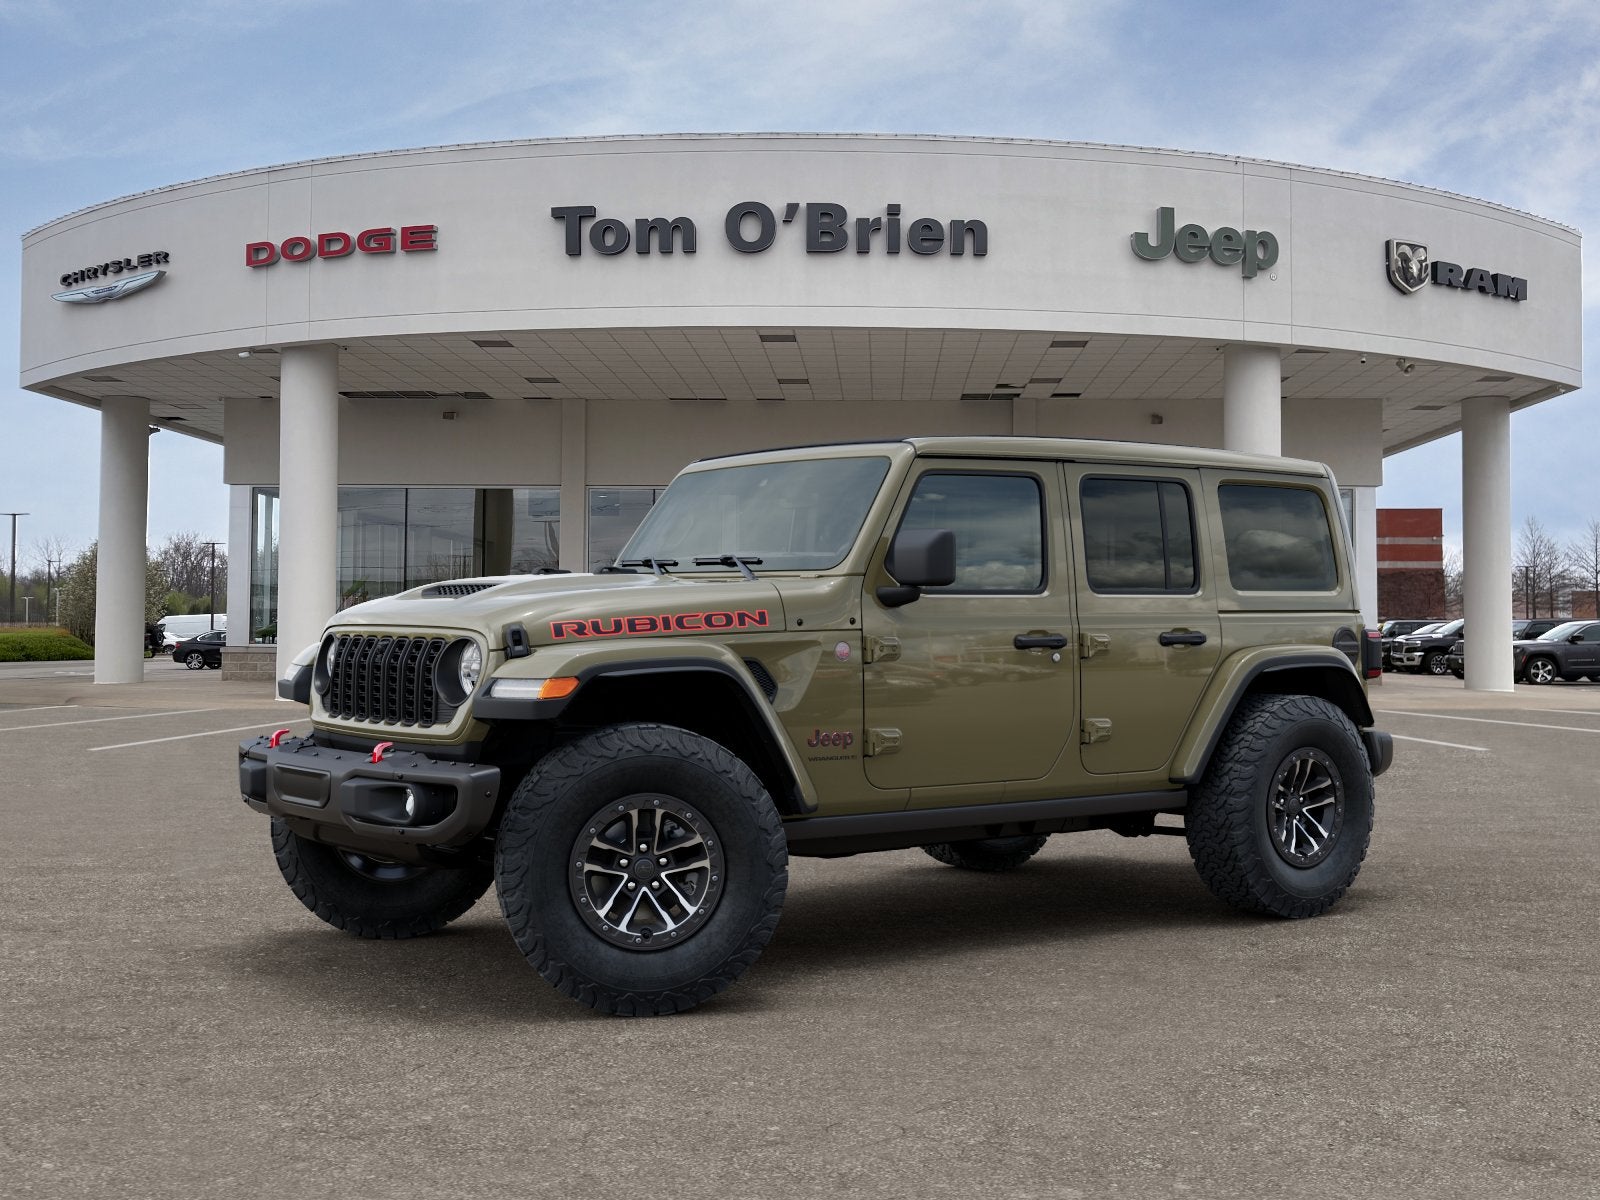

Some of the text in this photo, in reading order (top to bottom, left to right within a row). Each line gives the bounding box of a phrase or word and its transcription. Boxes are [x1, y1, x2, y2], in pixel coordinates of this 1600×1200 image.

[246, 225, 438, 268] DODGE
[551, 201, 988, 256] Tom O'Brien
[1131, 207, 1279, 278] Jeep
[60, 250, 170, 287] CHRYSLER
[1430, 261, 1528, 301] RAM
[550, 610, 769, 639] RUBICON
[807, 729, 854, 750] Jeep
